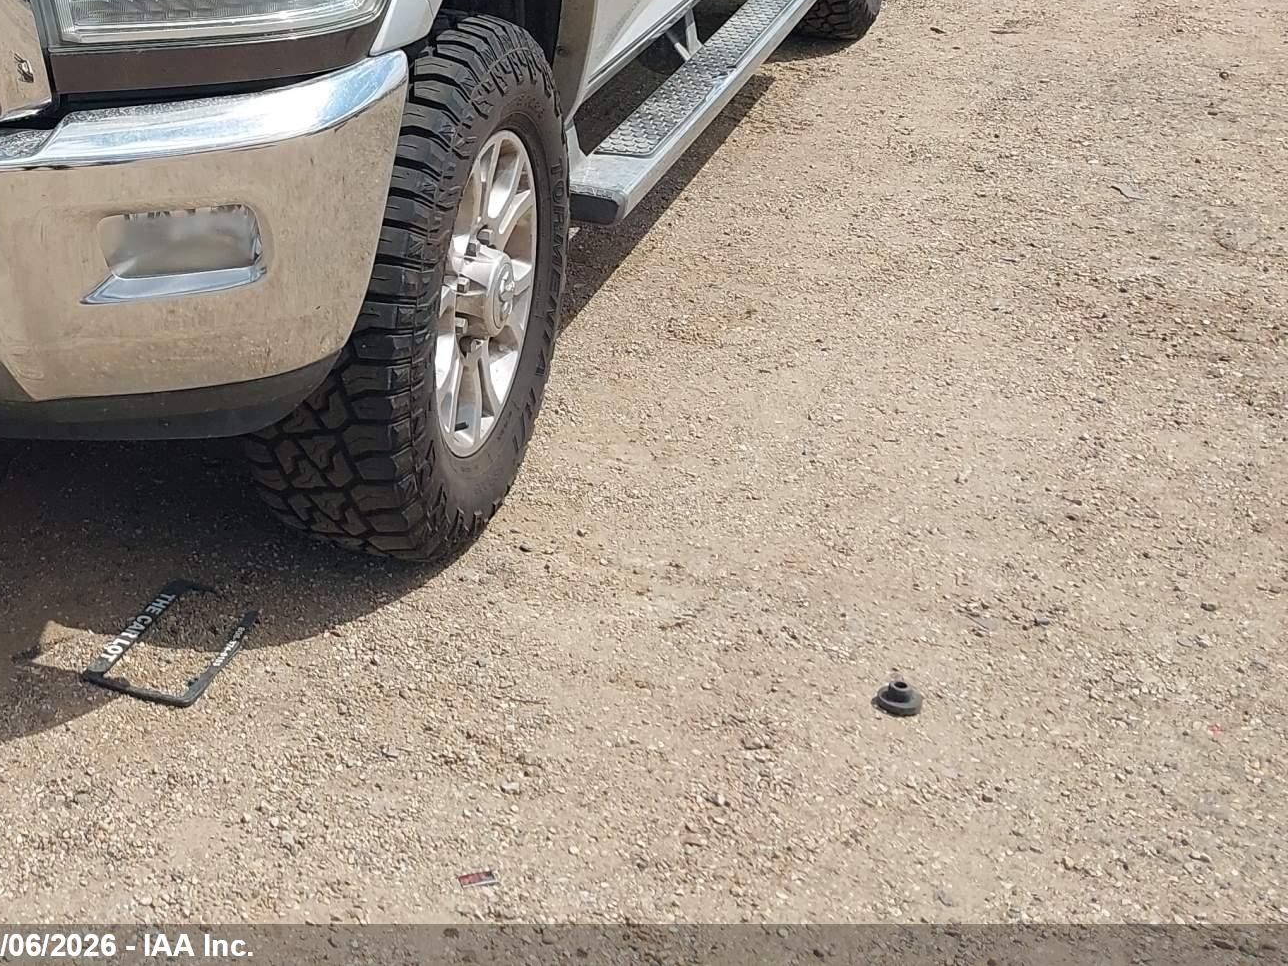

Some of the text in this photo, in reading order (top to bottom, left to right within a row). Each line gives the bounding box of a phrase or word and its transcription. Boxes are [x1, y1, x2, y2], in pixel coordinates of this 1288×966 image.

[100, 592, 177, 663] THE CAR LOT
